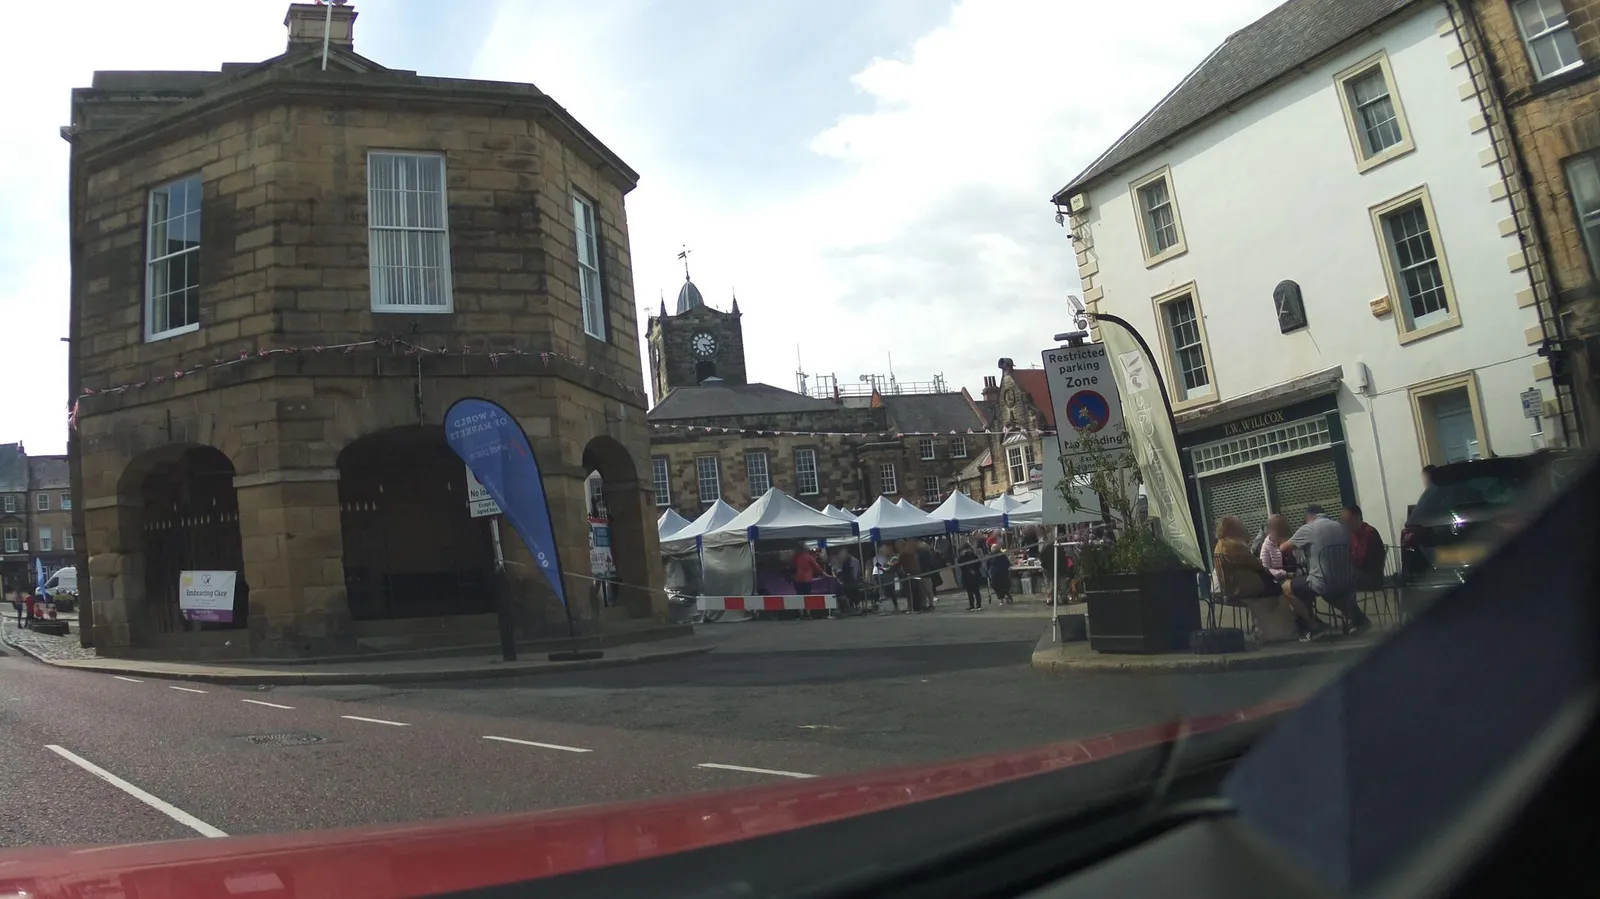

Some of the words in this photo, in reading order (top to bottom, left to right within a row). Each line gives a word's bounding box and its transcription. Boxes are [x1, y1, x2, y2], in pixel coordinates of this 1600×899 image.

[1048, 348, 1105, 363] Restricted
[1059, 361, 1100, 375] parking
[1066, 376, 1098, 388] Zone
[470, 489, 480, 498] No
[186, 589, 213, 598] Embracing
